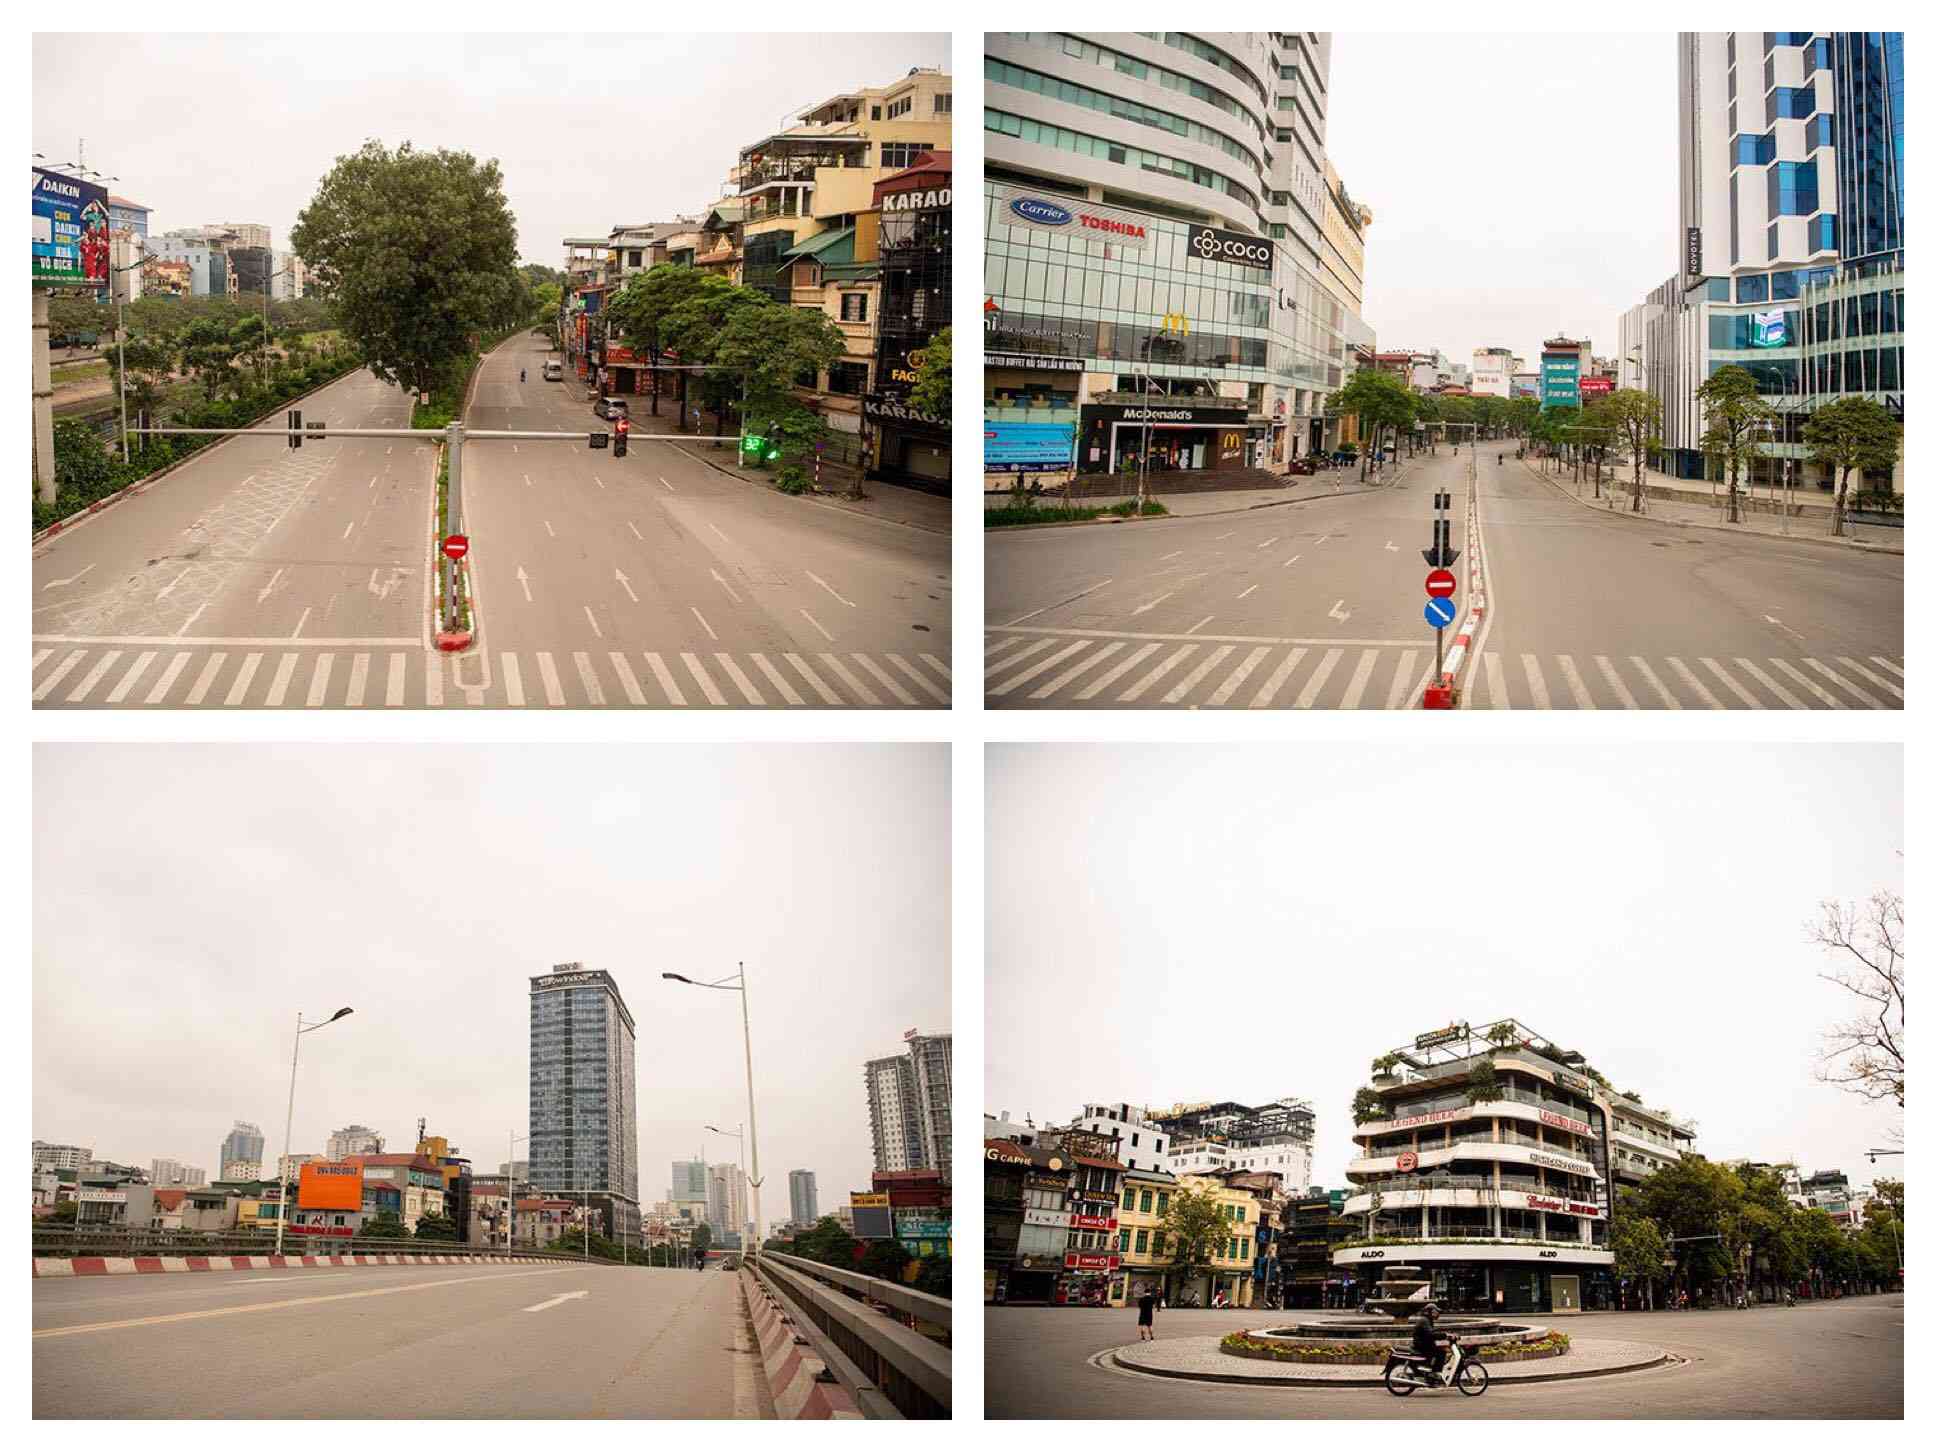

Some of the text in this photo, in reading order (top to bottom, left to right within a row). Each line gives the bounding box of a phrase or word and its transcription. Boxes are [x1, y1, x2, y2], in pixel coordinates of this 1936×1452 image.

[42, 179, 80, 199] DAIKIN
[1020, 201, 1064, 221] Carrier
[1080, 214, 1146, 239] TOSHIBA
[1224, 240, 1269, 261] COCO
[1123, 408, 1192, 421] McDonald's
[1361, 1251, 1384, 1259] ALDO
[1539, 1250, 1557, 1258] ALDO
